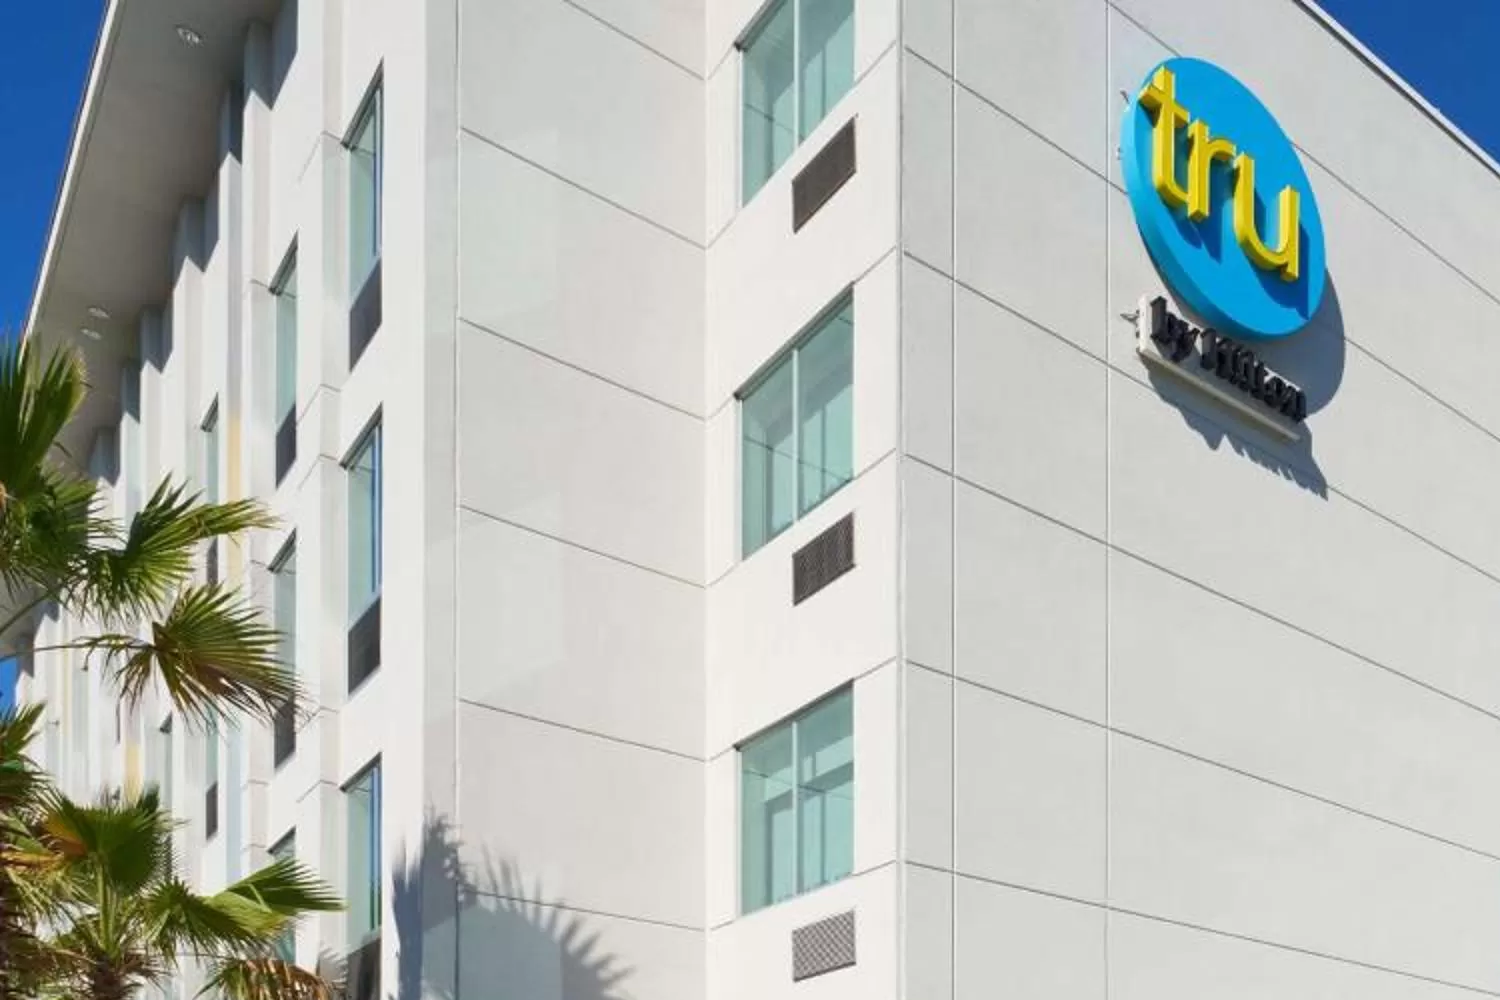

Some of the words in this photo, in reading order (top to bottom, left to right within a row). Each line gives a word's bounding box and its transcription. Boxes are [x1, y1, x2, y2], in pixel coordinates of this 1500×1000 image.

[1139, 66, 1300, 282] tru
[1151, 296, 1200, 362] by
[1200, 328, 1306, 422] Hilton
